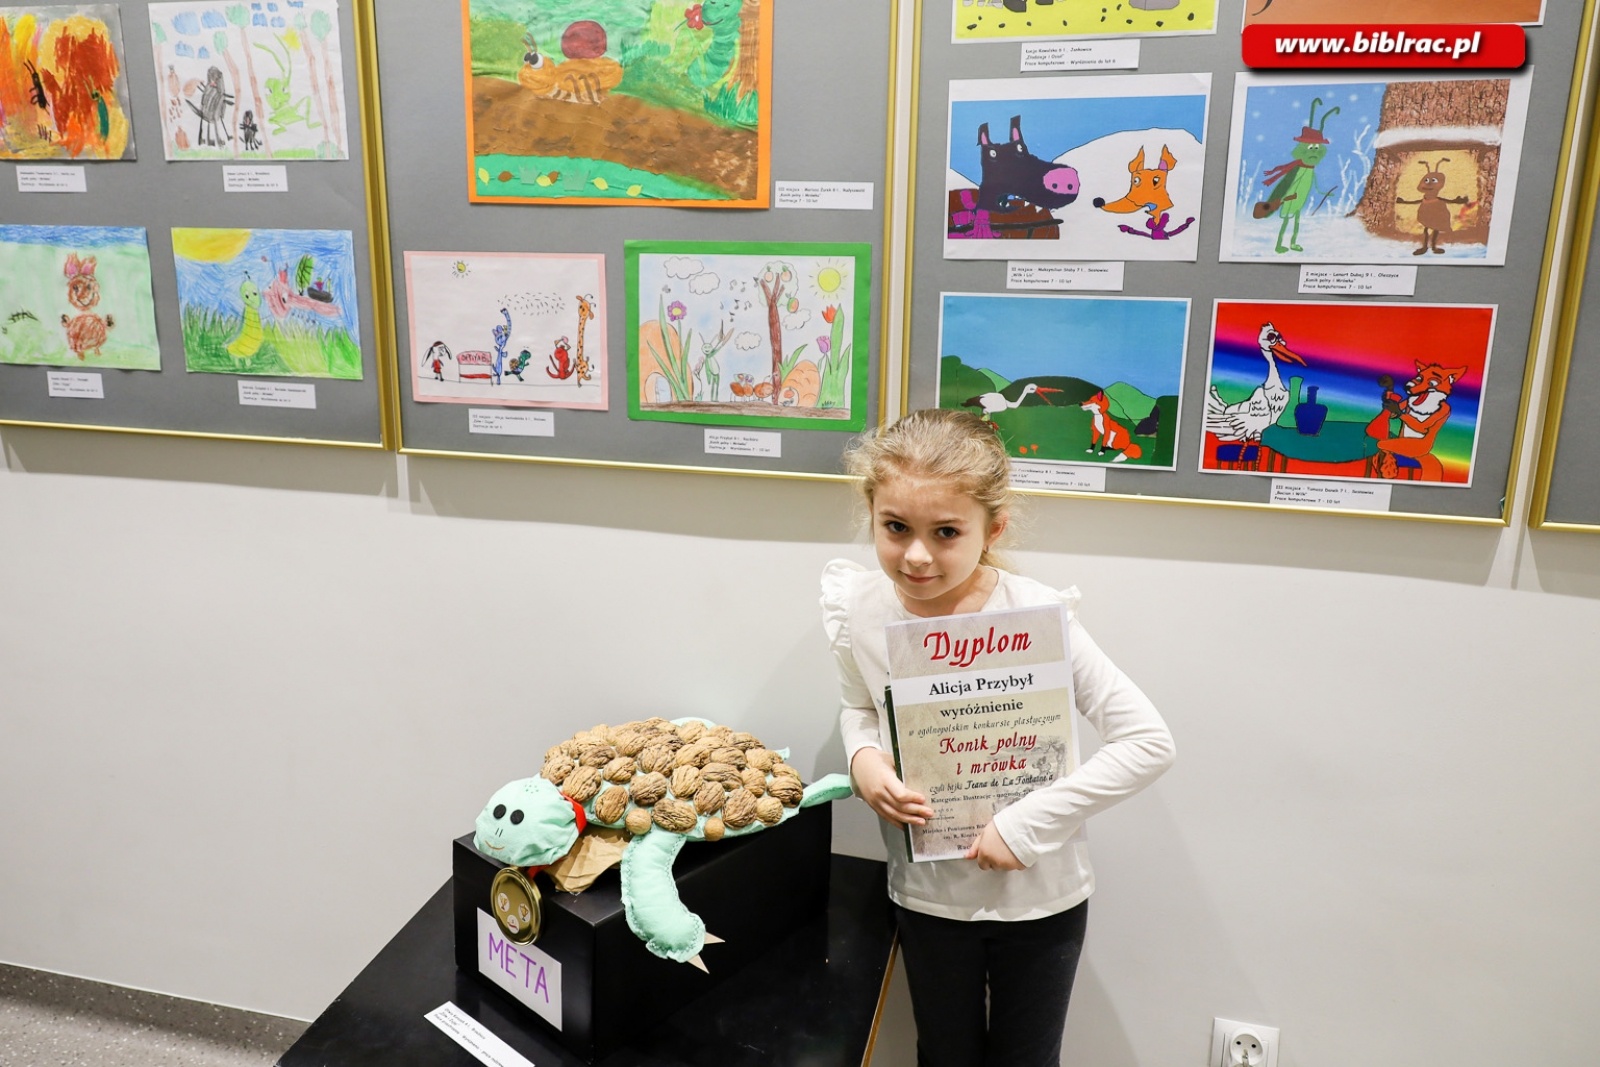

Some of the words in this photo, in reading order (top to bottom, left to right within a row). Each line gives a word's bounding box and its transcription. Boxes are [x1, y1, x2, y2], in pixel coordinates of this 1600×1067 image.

[924, 626, 1032, 668] Dyplom
[929, 680, 972, 696] Alicja
[976, 673, 1034, 692] Przybył
[940, 699, 1024, 720] wyróżnienie
[918, 724, 969, 738] ogólnopolskim
[974, 720, 1010, 729] konkursie
[1012, 714, 1062, 729] plastycznym
[940, 735, 988, 754] Konik
[990, 732, 1037, 756] polny
[956, 763, 962, 775] i
[970, 755, 1027, 774] mrówka
[990, 779, 998, 787] de
[1002, 777, 1013, 787] La
[489, 932, 549, 1003] META
